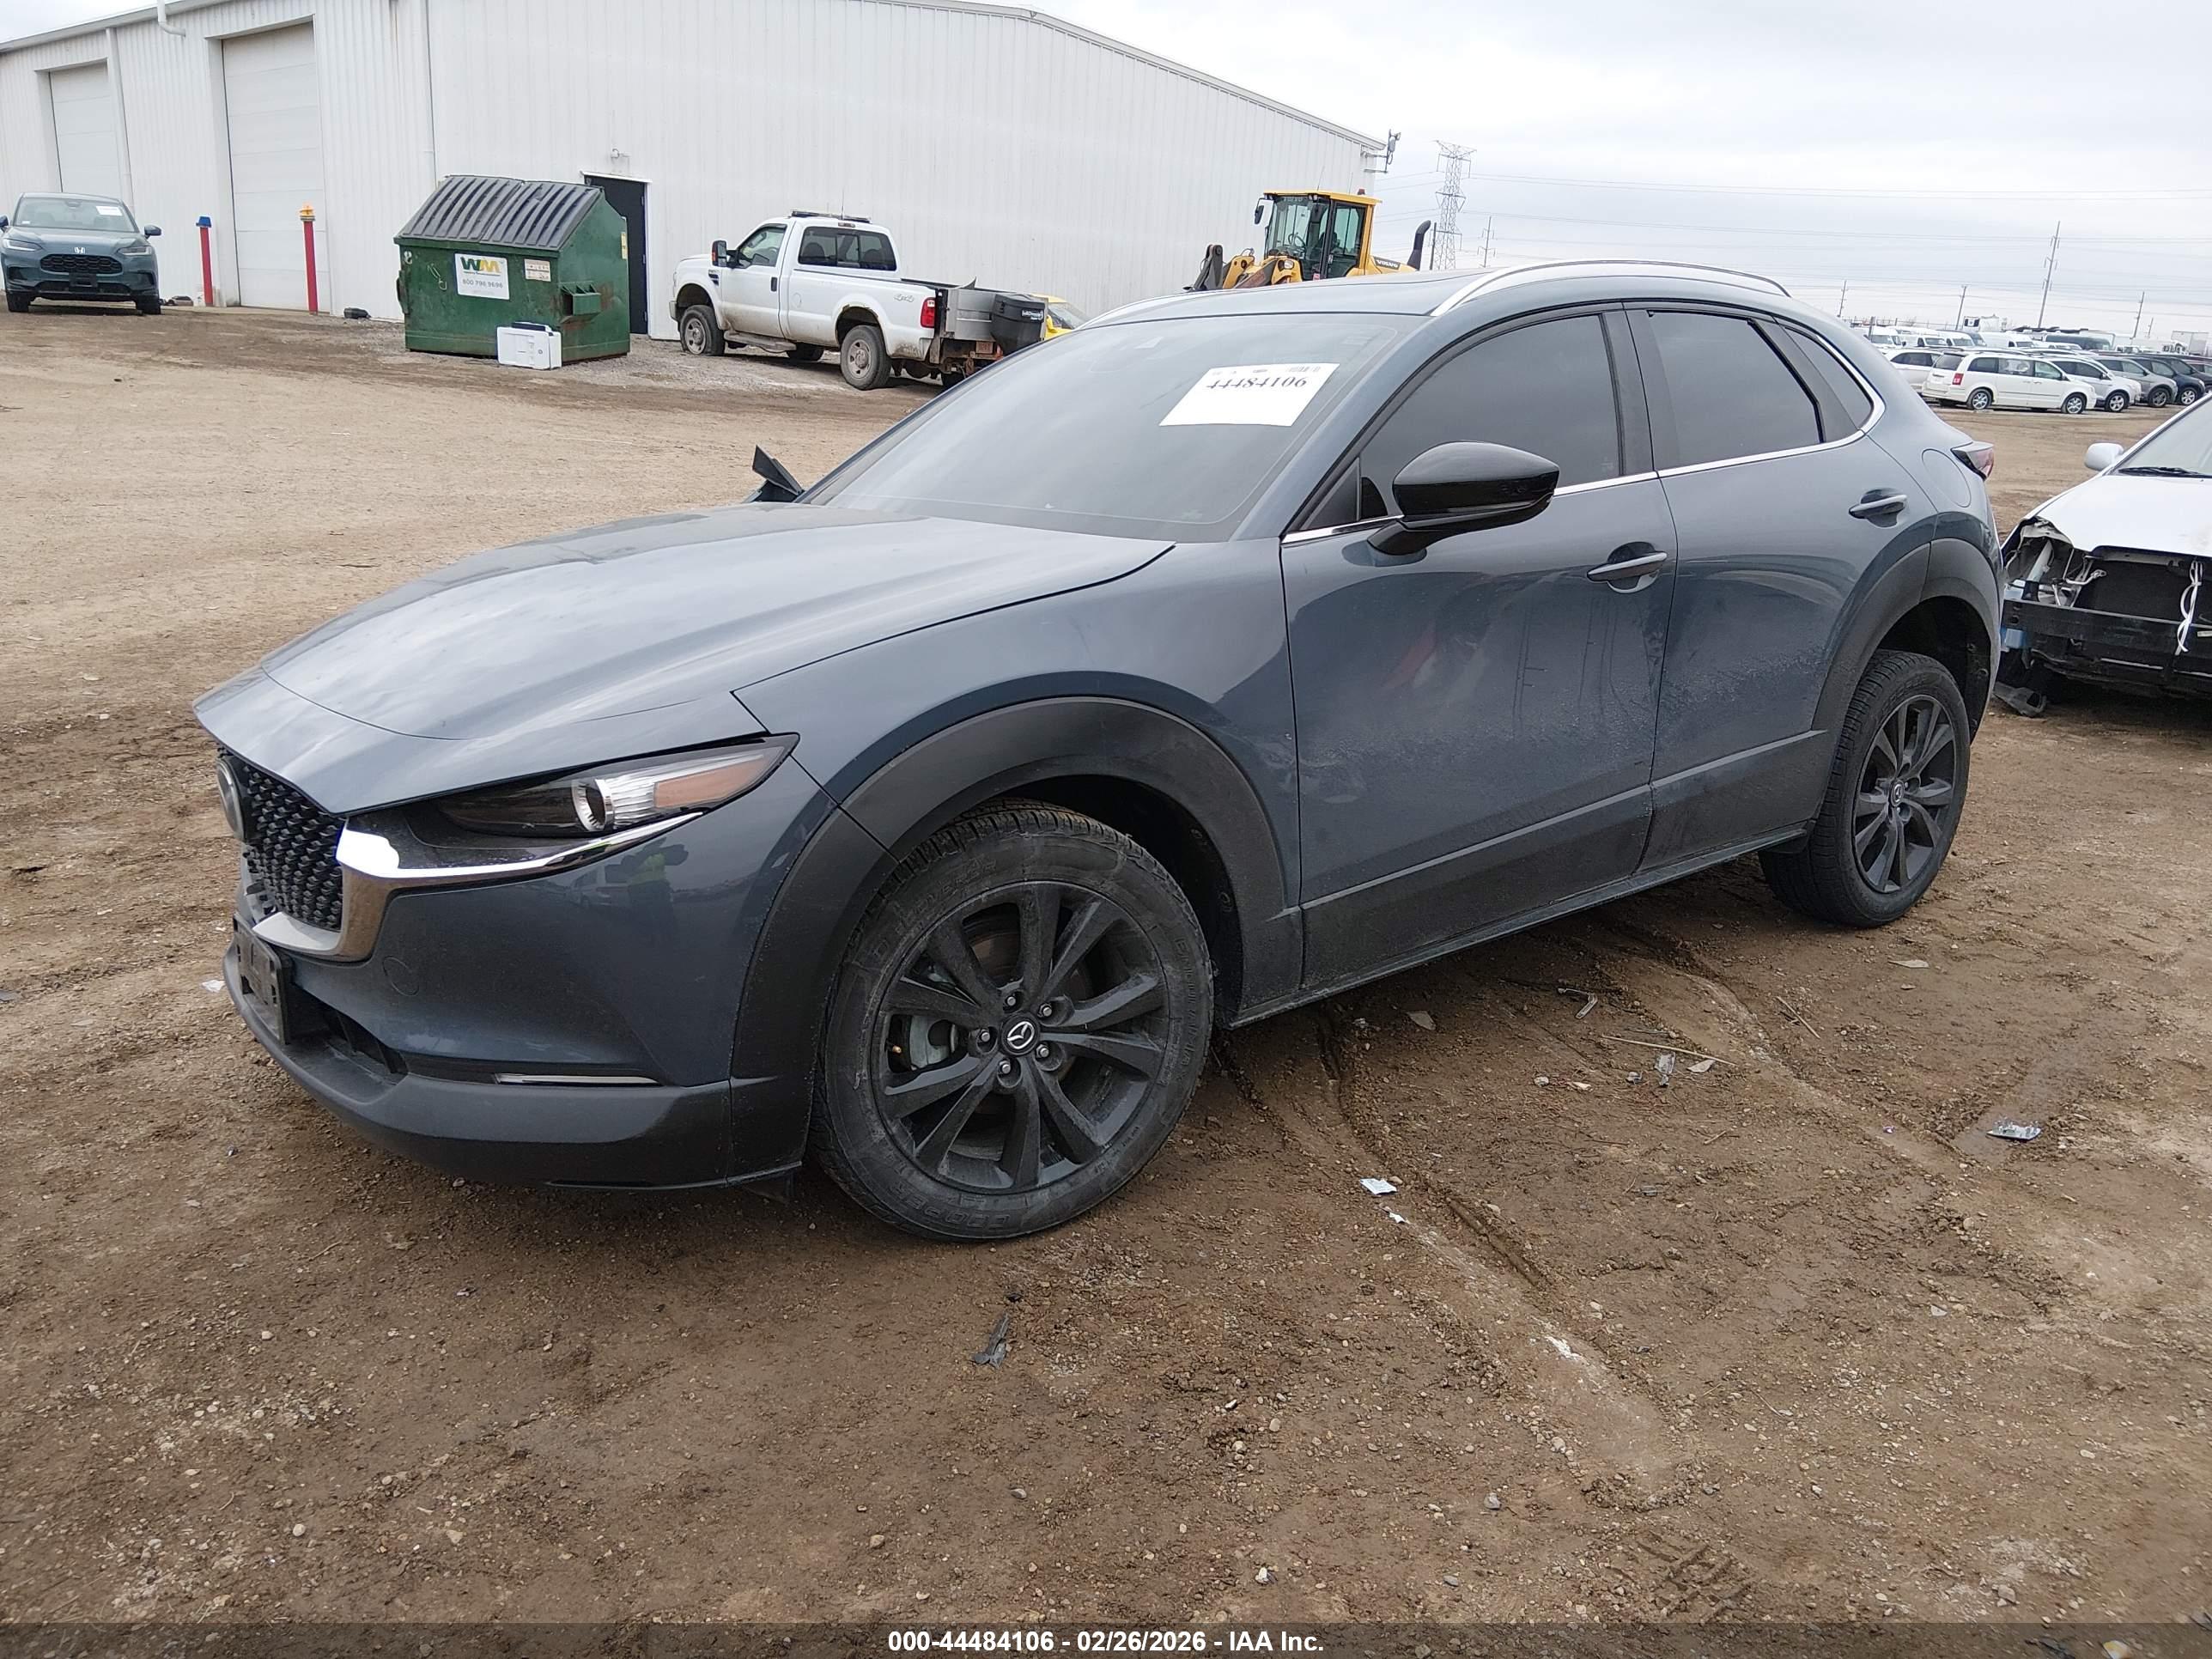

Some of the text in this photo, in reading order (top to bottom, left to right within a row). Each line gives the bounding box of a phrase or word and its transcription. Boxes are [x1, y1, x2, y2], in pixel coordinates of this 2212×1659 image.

[460, 257, 501, 273] WM
[1376, 259, 1399, 269] VOLVO
[1206, 376, 1308, 390] 44484106
